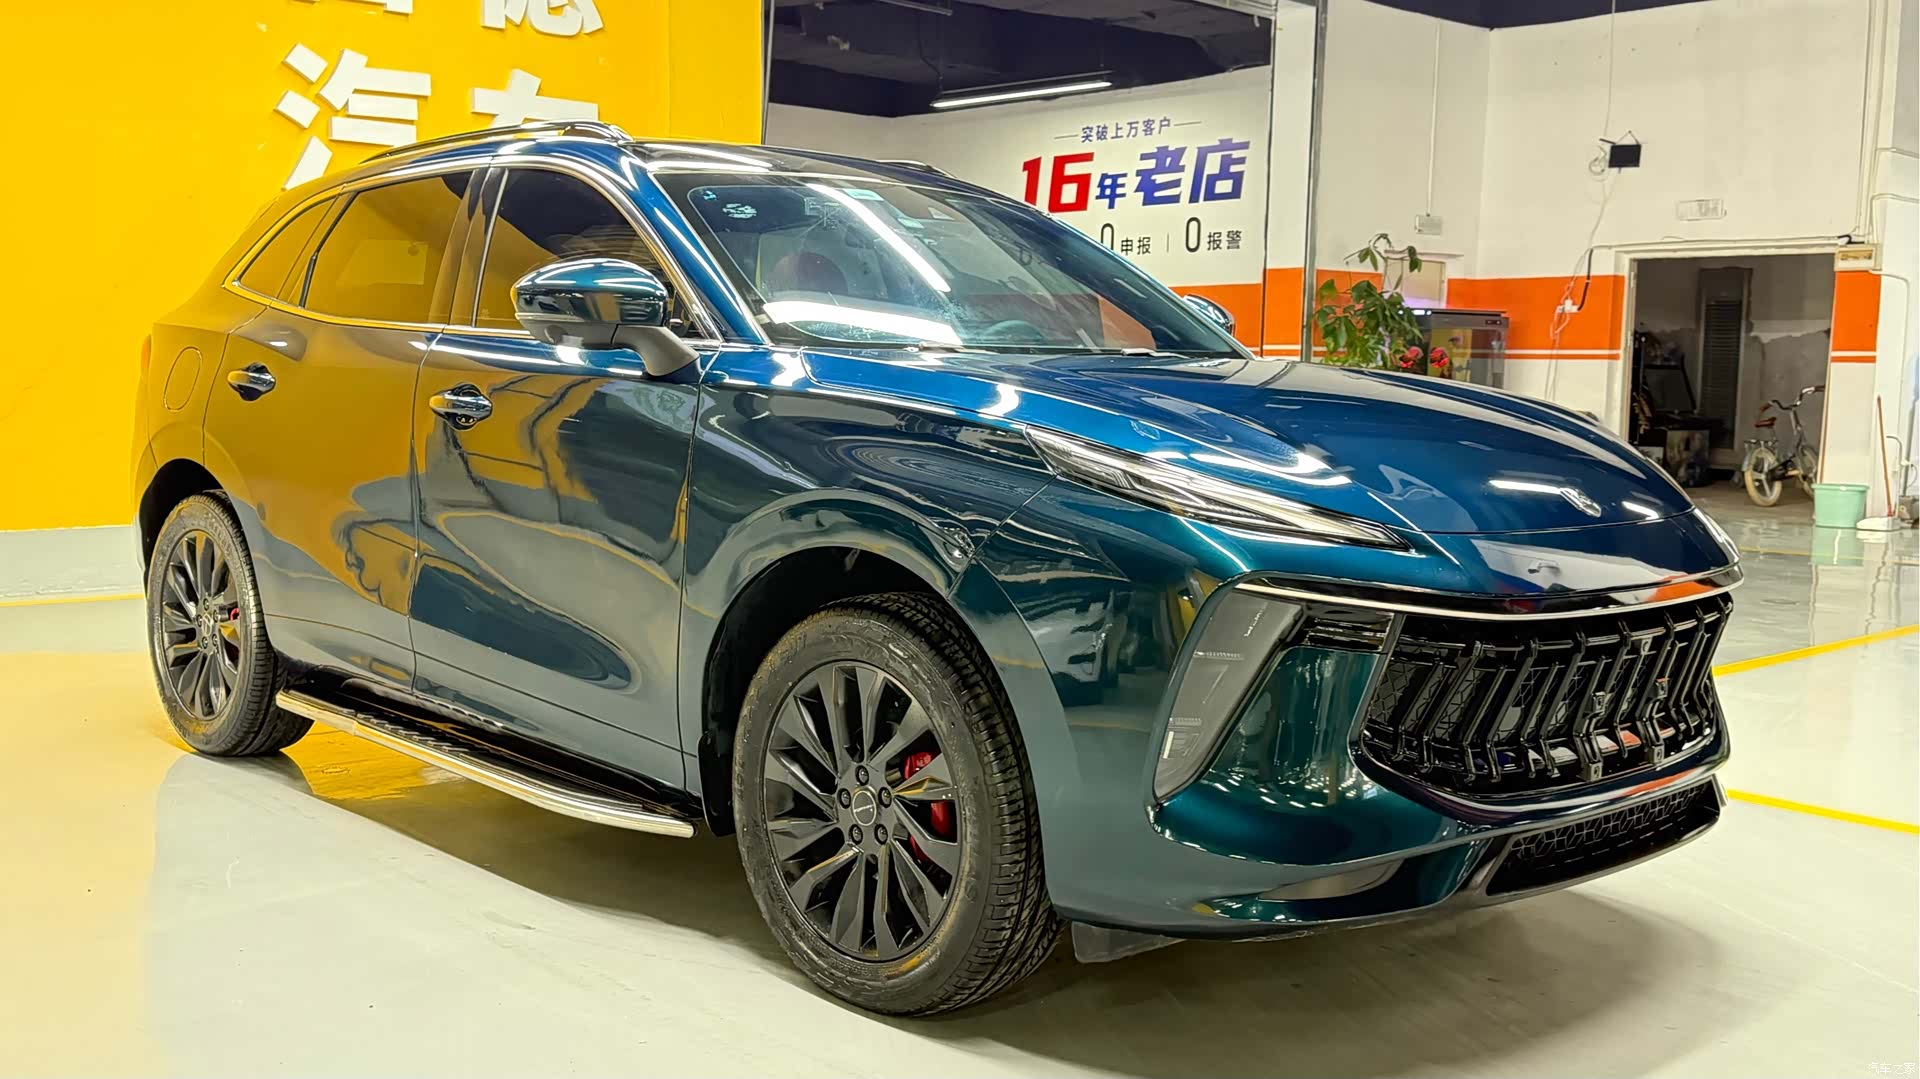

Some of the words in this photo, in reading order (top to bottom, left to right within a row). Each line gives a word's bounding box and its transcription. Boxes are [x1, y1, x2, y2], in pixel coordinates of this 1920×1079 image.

[1081, 116, 1171, 143] 突破上万客户
[1022, 138, 1250, 214] 16年老店
